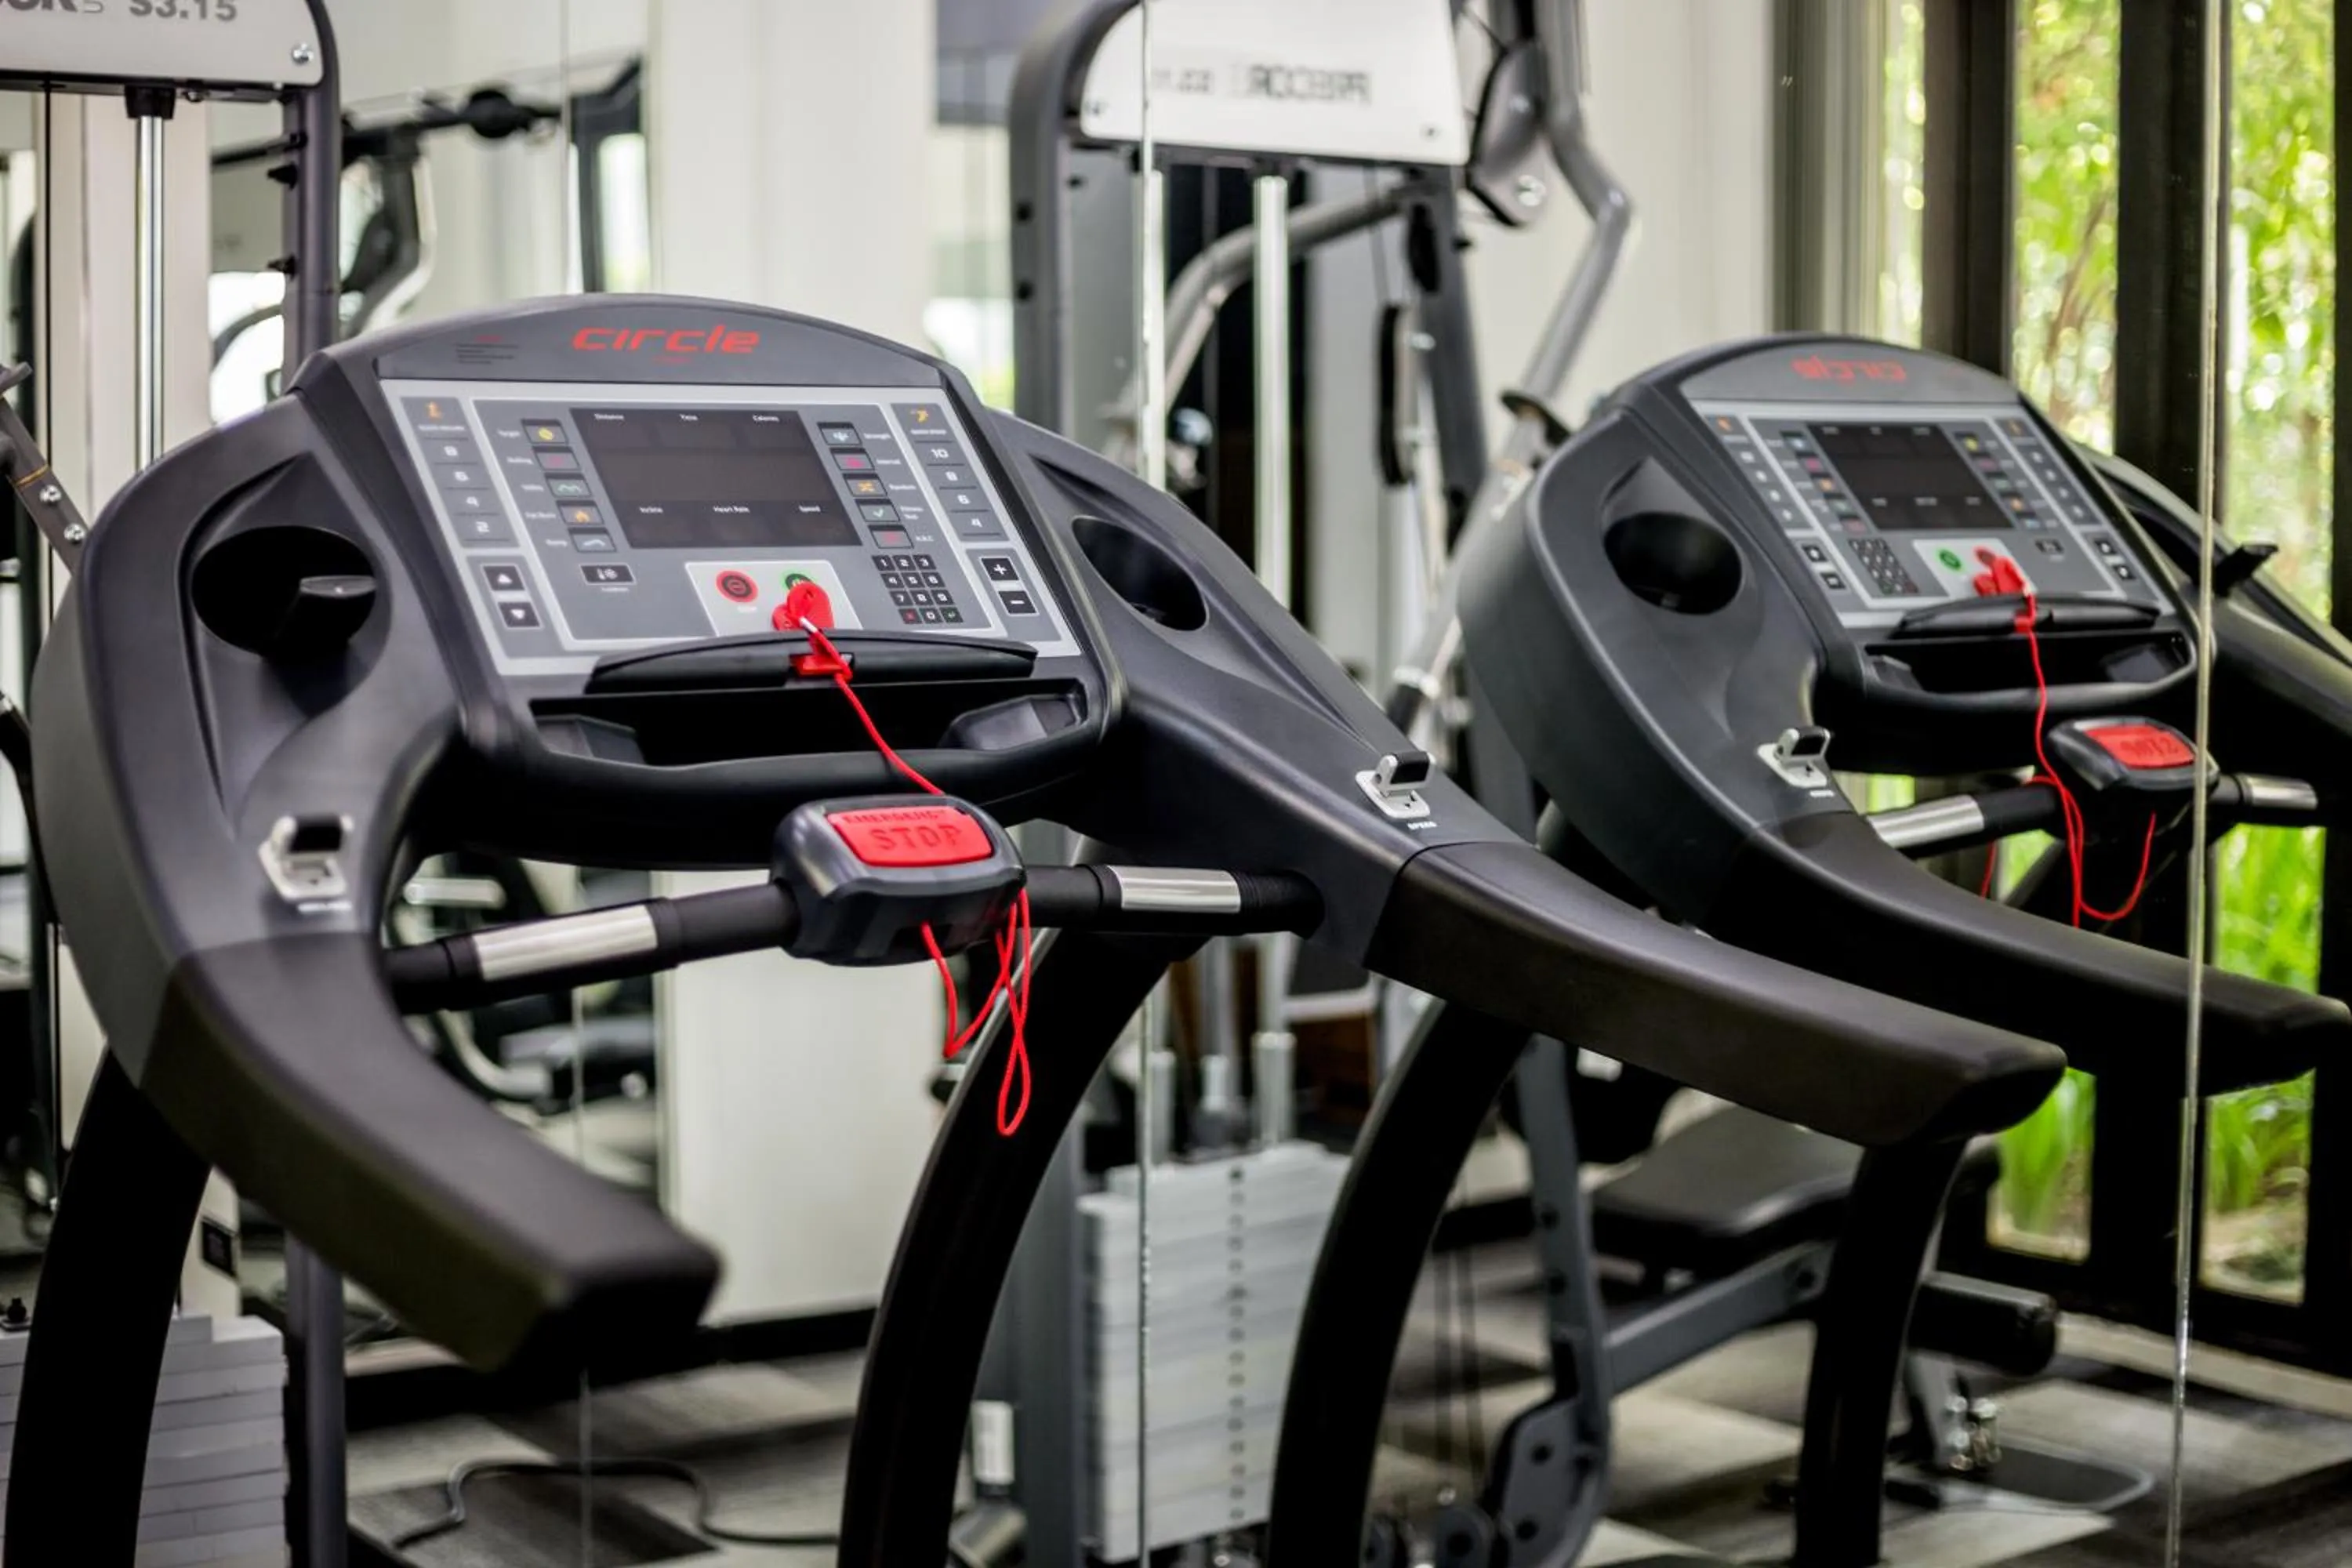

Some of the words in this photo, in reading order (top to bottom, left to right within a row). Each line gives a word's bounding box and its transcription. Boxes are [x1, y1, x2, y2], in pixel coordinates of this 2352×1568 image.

[572, 325, 760, 353] circle
[931, 448, 949, 459] 10
[475, 521, 490, 533] 2
[869, 825, 962, 851] STOP
